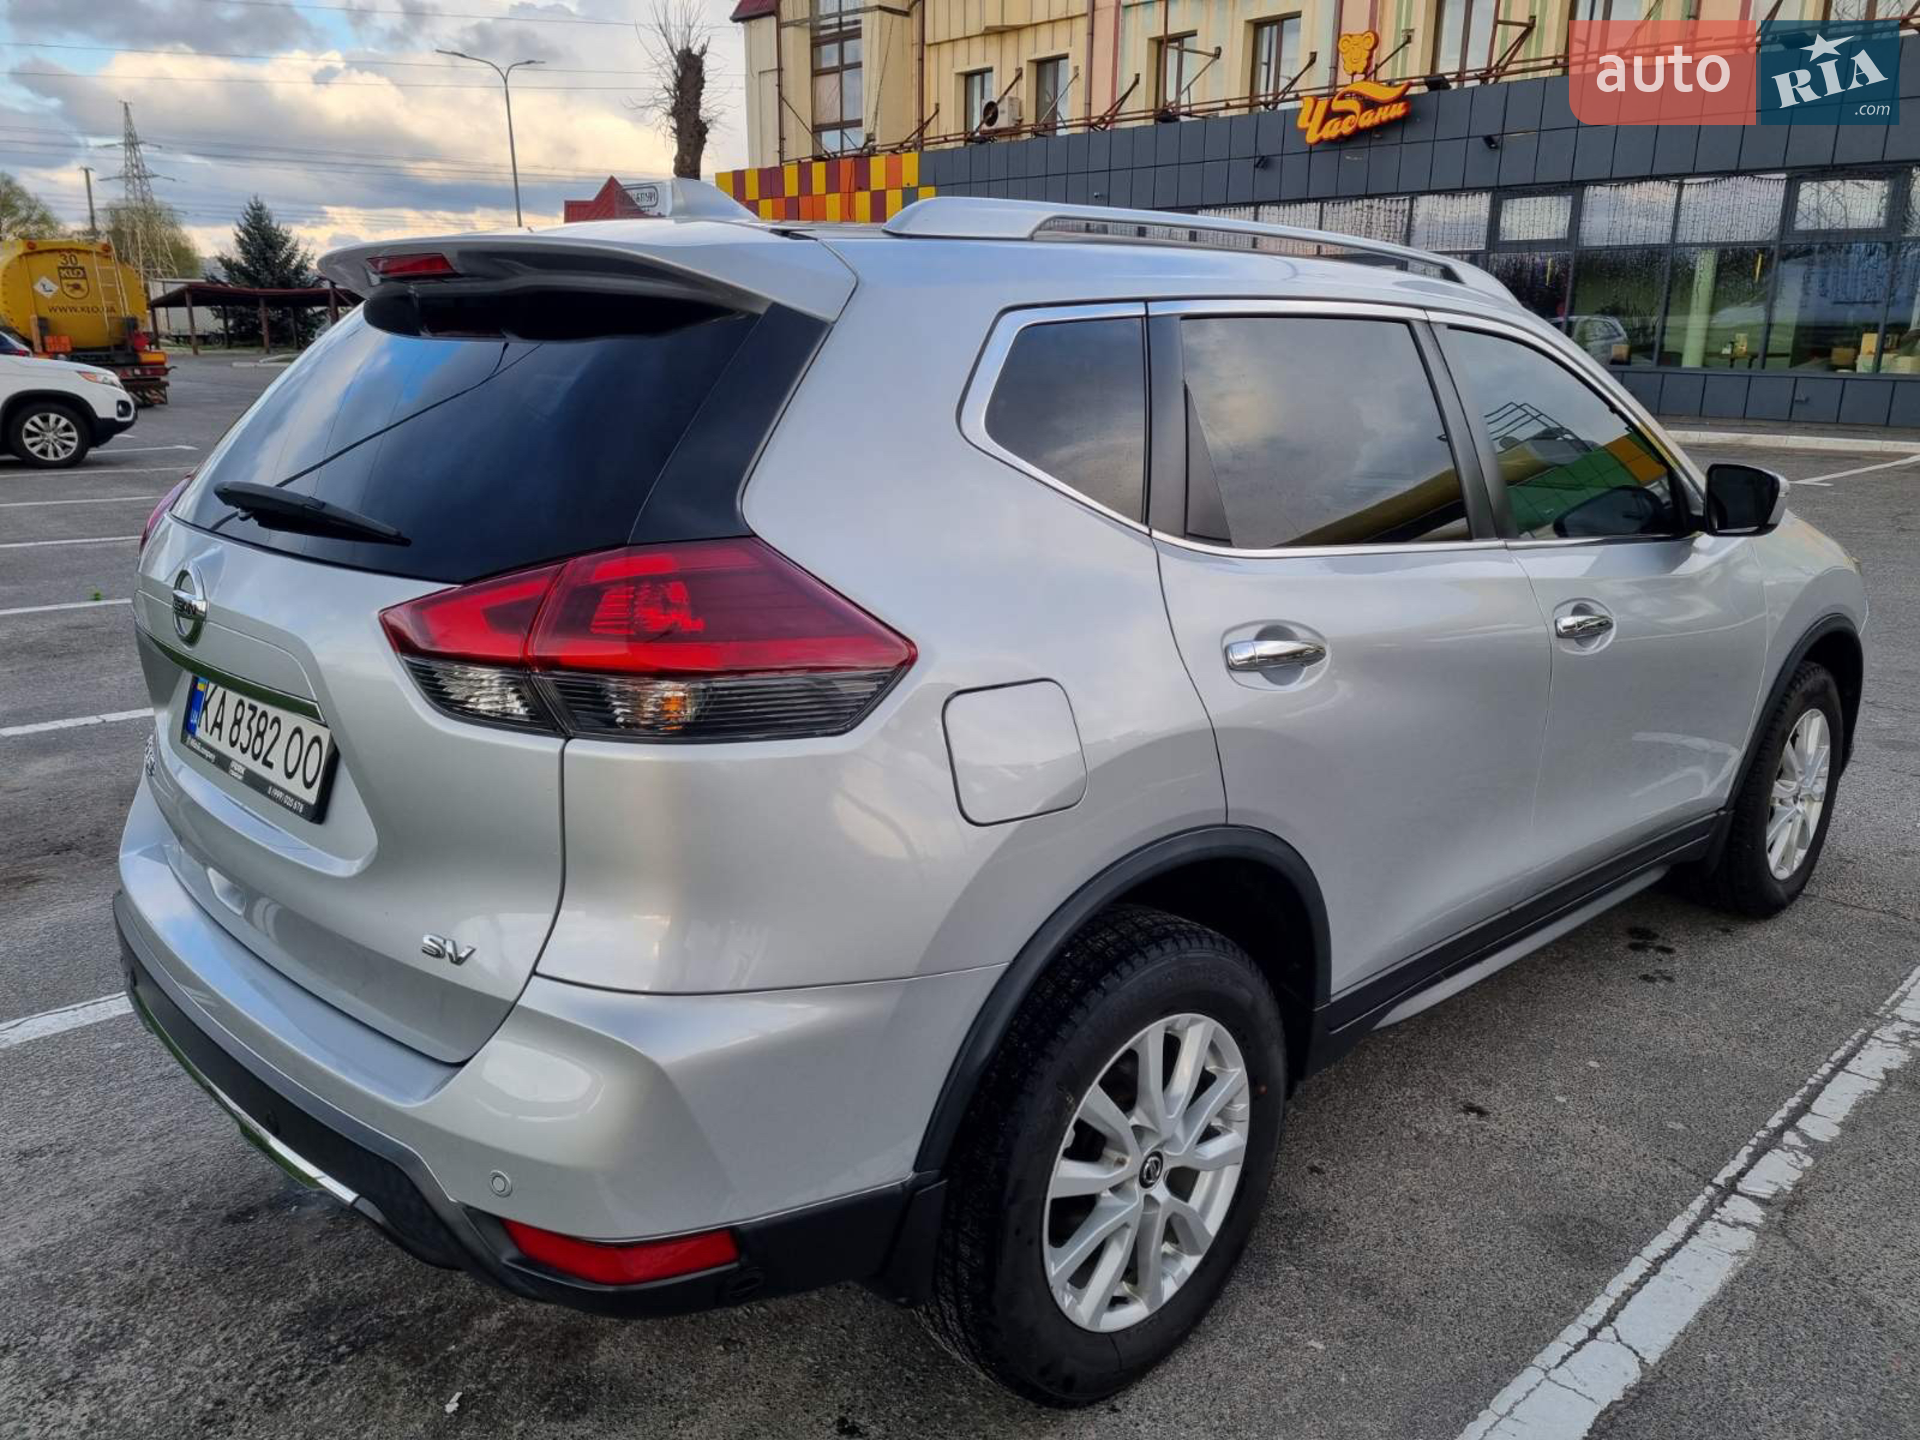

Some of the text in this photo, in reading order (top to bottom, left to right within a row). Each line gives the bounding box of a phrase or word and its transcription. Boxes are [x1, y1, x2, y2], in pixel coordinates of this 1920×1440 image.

[61, 254, 78, 266] 30
[60, 268, 84, 278] KLO
[198, 685, 226, 741] KA
[229, 699, 281, 770] 8382
[421, 934, 476, 966] SV
